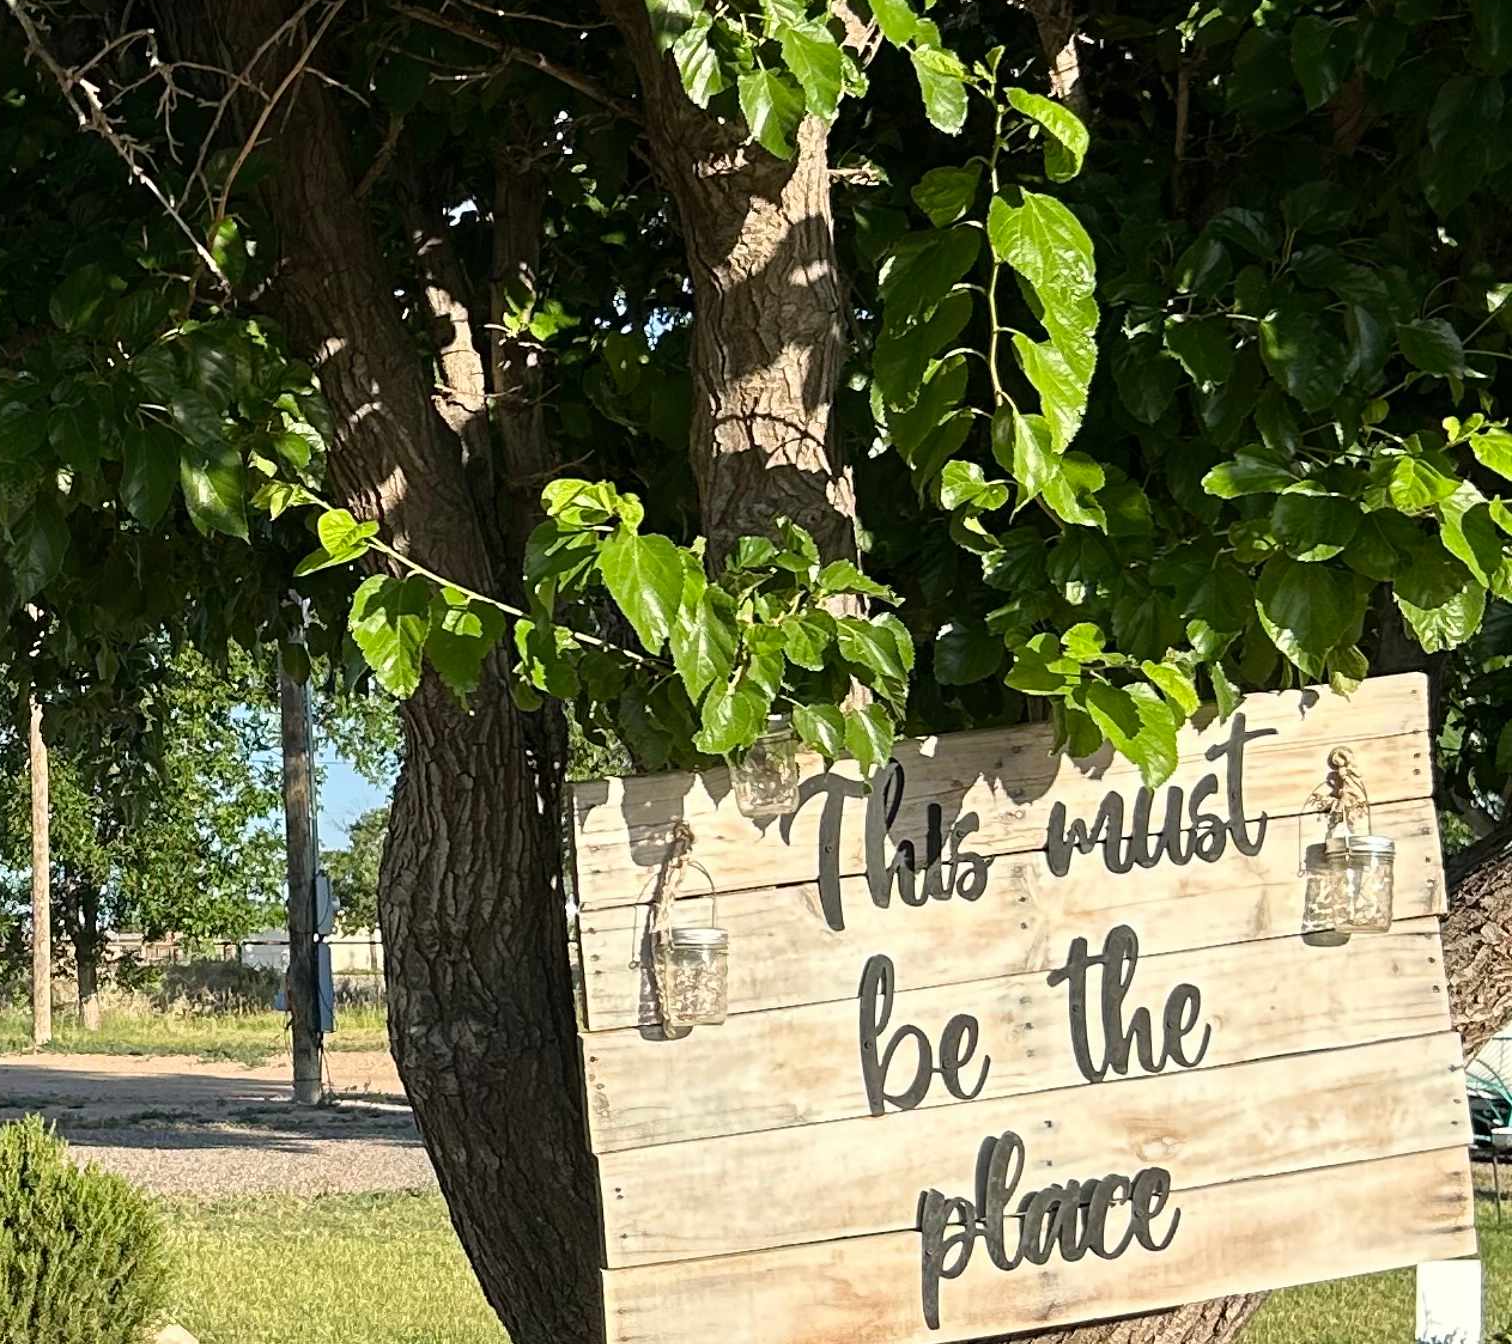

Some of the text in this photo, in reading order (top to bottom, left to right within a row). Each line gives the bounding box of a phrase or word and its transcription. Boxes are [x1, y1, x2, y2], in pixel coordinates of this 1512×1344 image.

[779, 712, 1278, 932] This must
[858, 924, 1212, 1116] be the
[916, 1130, 1181, 1331] place
